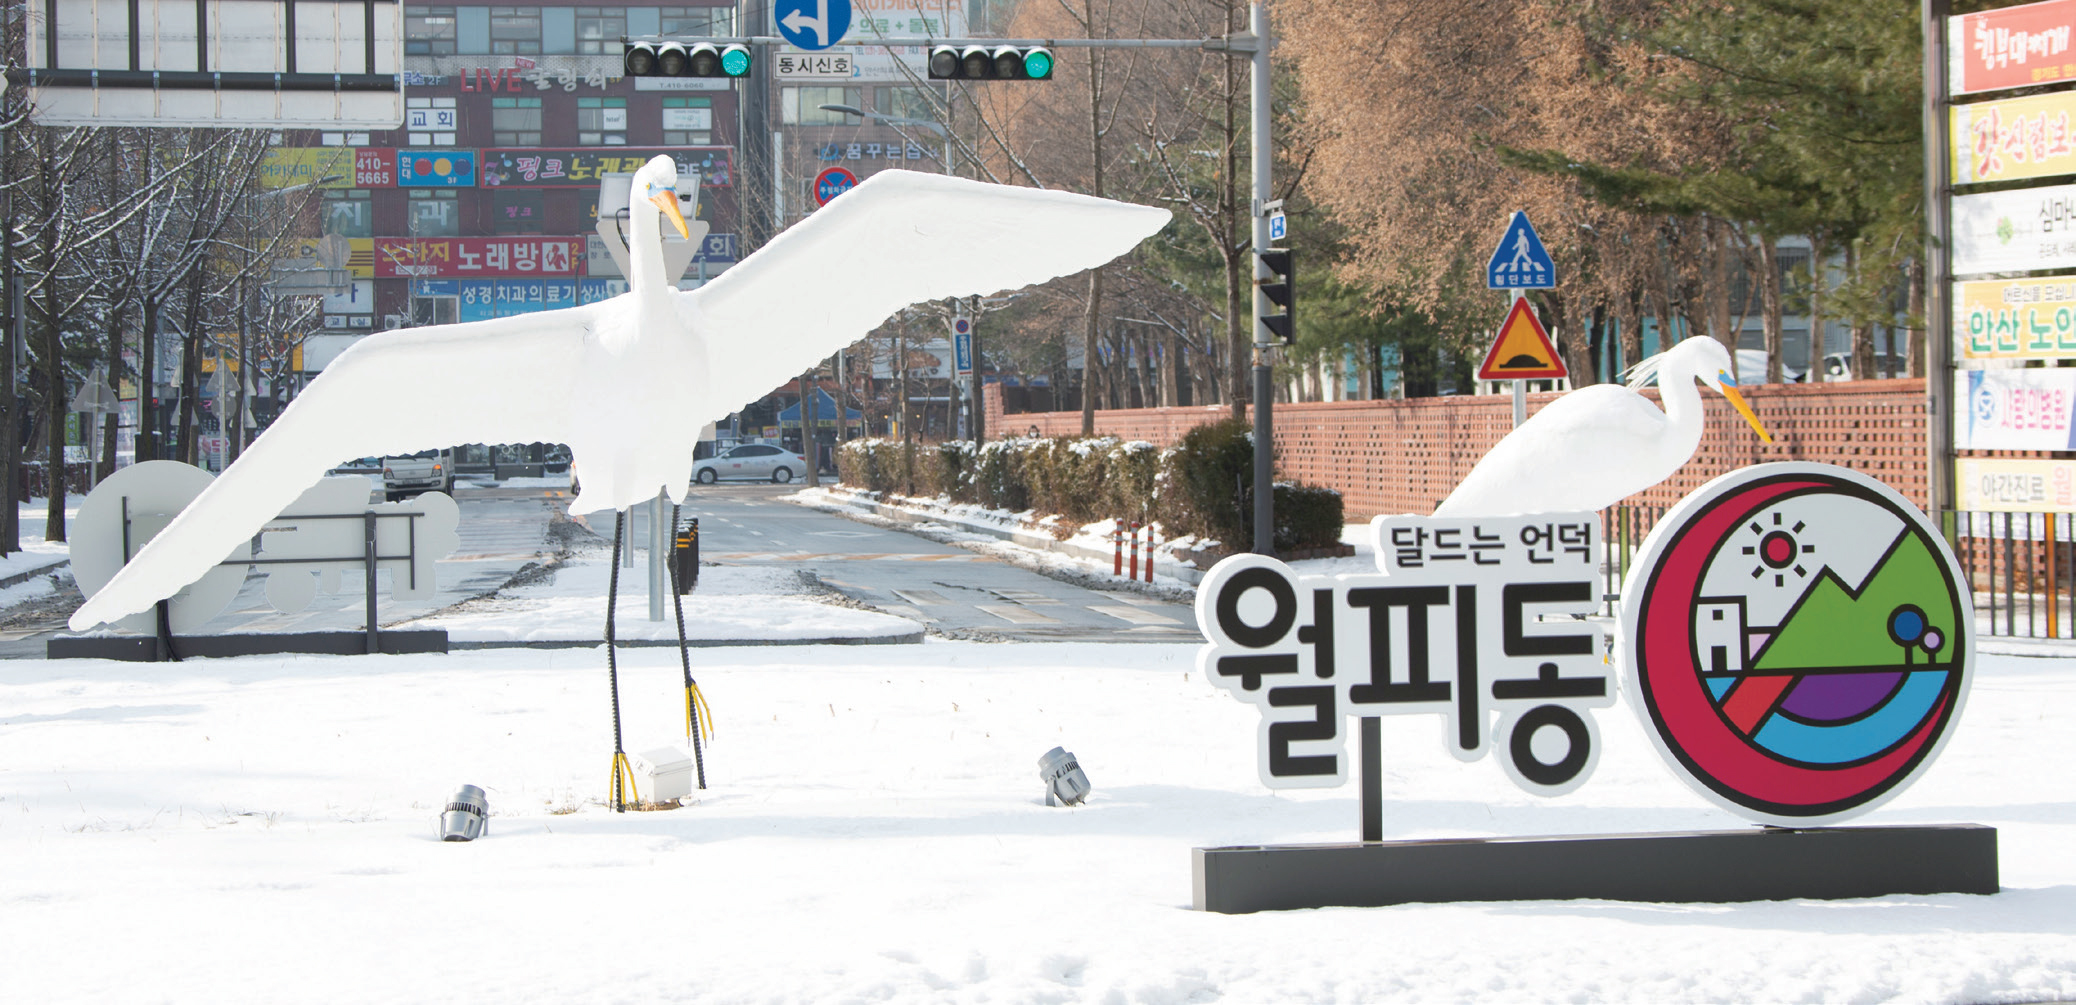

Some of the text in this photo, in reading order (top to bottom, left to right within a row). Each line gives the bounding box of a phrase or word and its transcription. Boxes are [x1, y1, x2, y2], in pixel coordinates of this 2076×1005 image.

[516, 58, 535, 68] NEW
[778, 57, 849, 74] 동시신호
[461, 68, 522, 92] LIVE
[411, 111, 453, 127] 교회
[356, 158, 391, 170] 410-
[401, 156, 411, 180] 현대
[516, 156, 565, 181] 핑크
[356, 172, 390, 184] 5665
[331, 202, 362, 226] 치
[418, 202, 450, 226] 과
[382, 241, 539, 271] 노다지 노래방
[1494, 274, 1547, 286] 횡단보도
[1971, 309, 2020, 352] 안산
[1982, 473, 2045, 502] 야간진료
[1391, 523, 1591, 568] 달드는 언덕
[1216, 566, 1607, 786] 월피동
